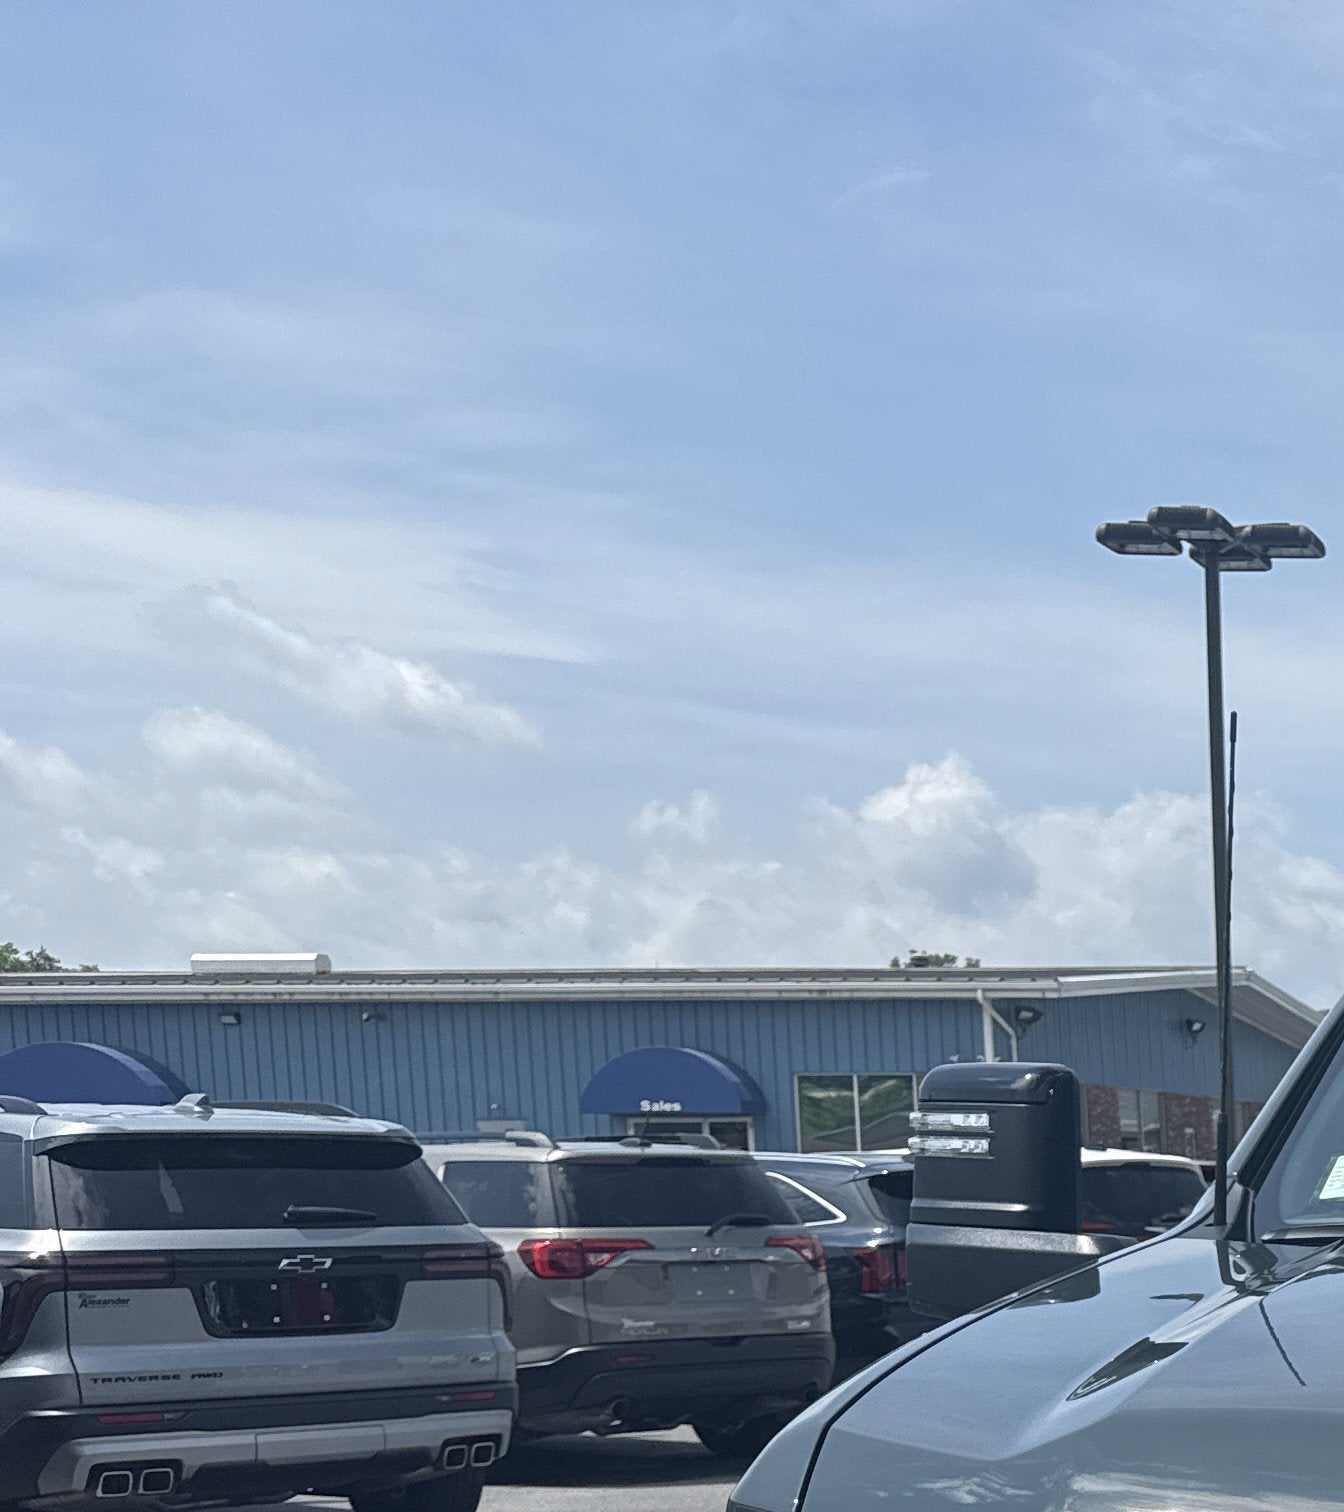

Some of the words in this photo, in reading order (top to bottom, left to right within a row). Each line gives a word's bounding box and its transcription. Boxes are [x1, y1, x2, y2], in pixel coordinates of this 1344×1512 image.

[640, 1099, 682, 1111] Sales
[90, 1373, 181, 1384] TRAVERSE
[190, 1371, 224, 1380] AWD
